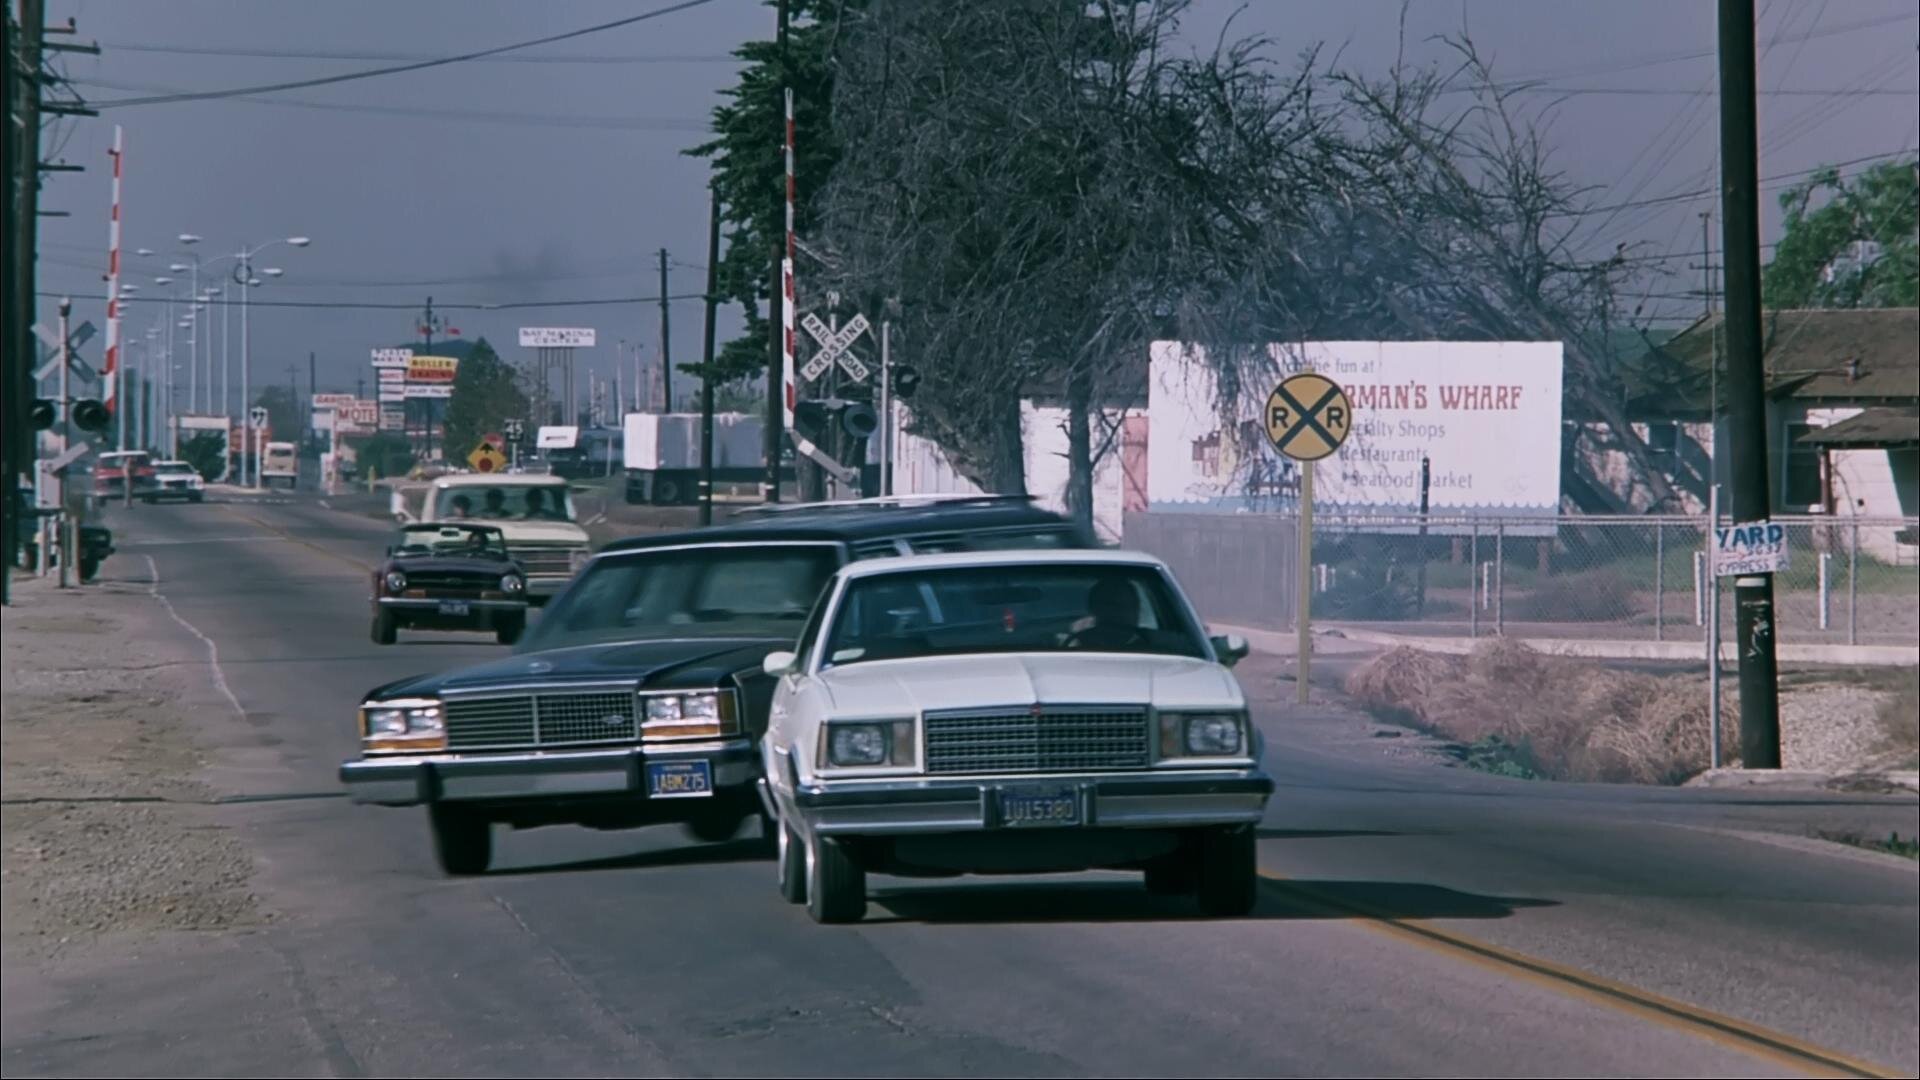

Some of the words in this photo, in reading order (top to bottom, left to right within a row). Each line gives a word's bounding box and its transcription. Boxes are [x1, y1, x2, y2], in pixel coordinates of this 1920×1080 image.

[807, 319, 864, 375] CROSSING
[412, 359, 452, 368] ROLLER
[1336, 358, 1357, 373] fun
[1361, 360, 1374, 373] at
[1440, 386, 1522, 410] WHARF
[506, 422, 523, 433] 45
[1271, 407, 1288, 429] R
[1327, 407, 1344, 429] R
[1398, 420, 1446, 441] Shops
[1418, 470, 1472, 488] arket
[1716, 525, 1783, 548] YARD
